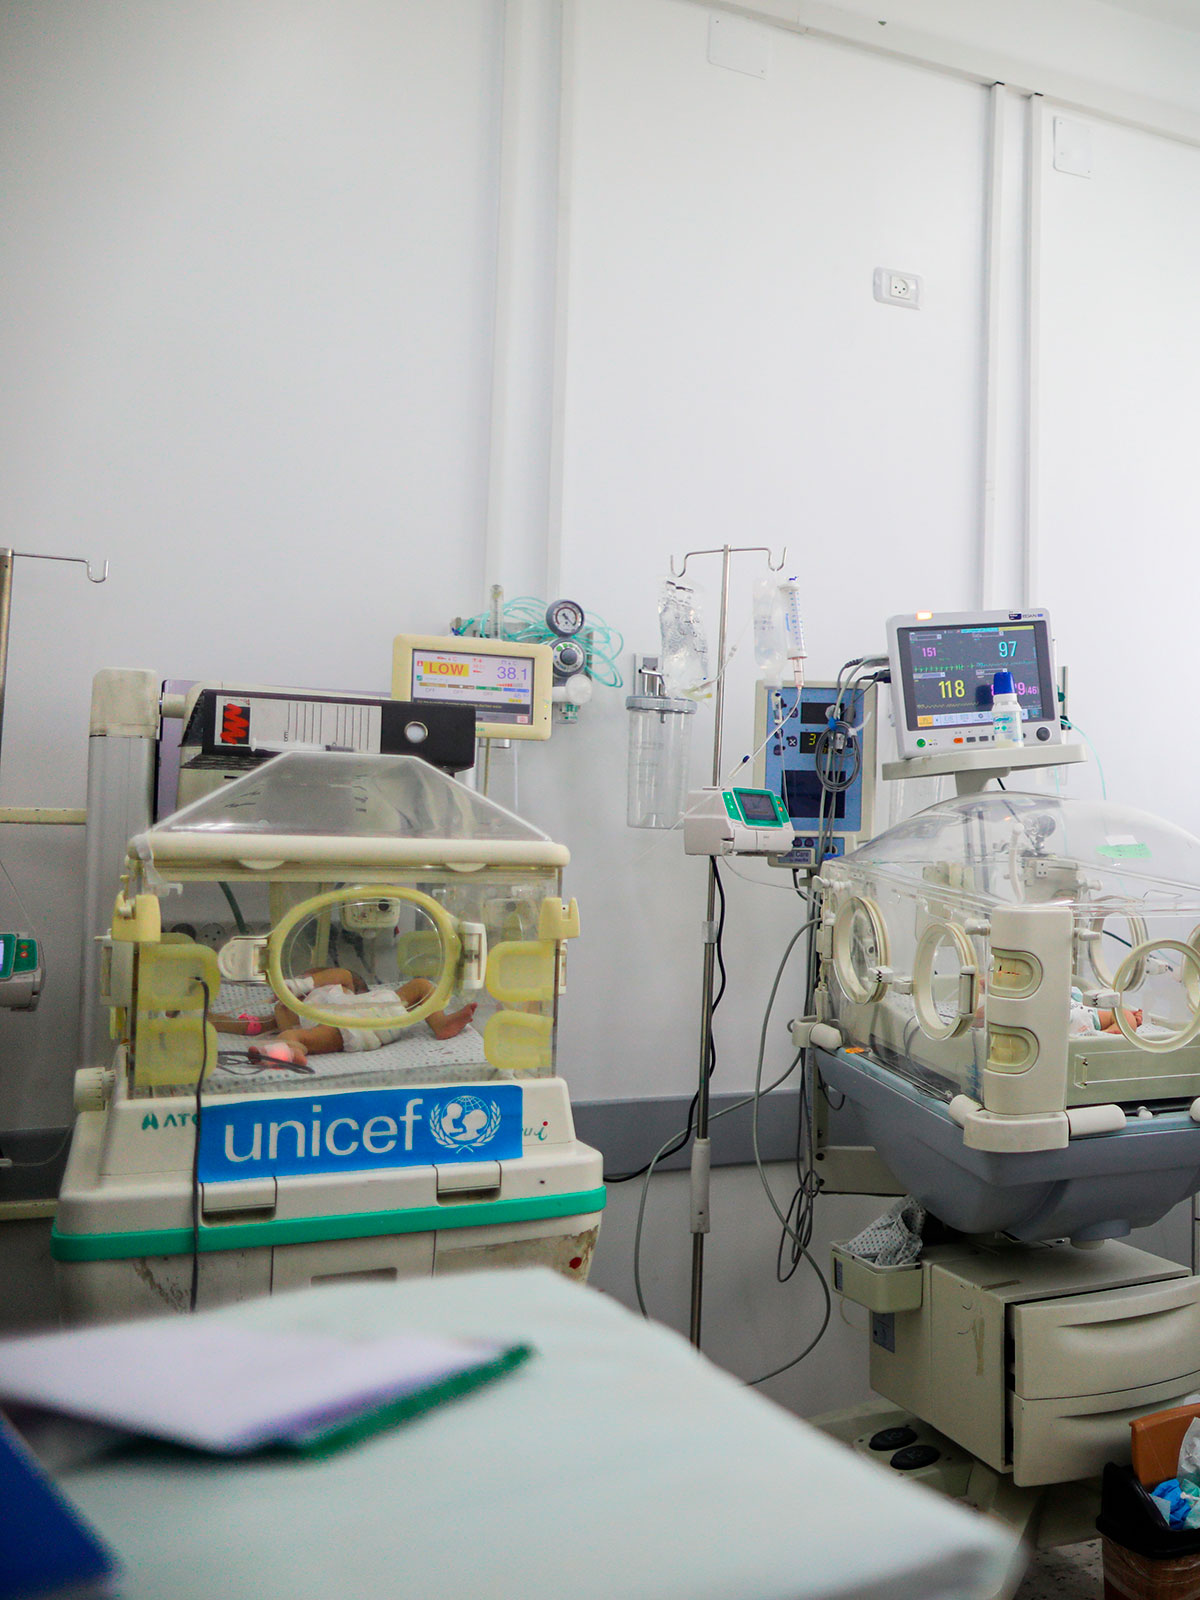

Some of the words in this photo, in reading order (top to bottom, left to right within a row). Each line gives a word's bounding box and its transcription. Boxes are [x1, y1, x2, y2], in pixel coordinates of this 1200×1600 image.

[922, 647, 937, 657] 151
[998, 640, 1018, 658] 97
[429, 663, 464, 675] LOW
[497, 666, 527, 681] 38.1
[938, 679, 966, 699] 118
[225, 1098, 424, 1162] unicef
